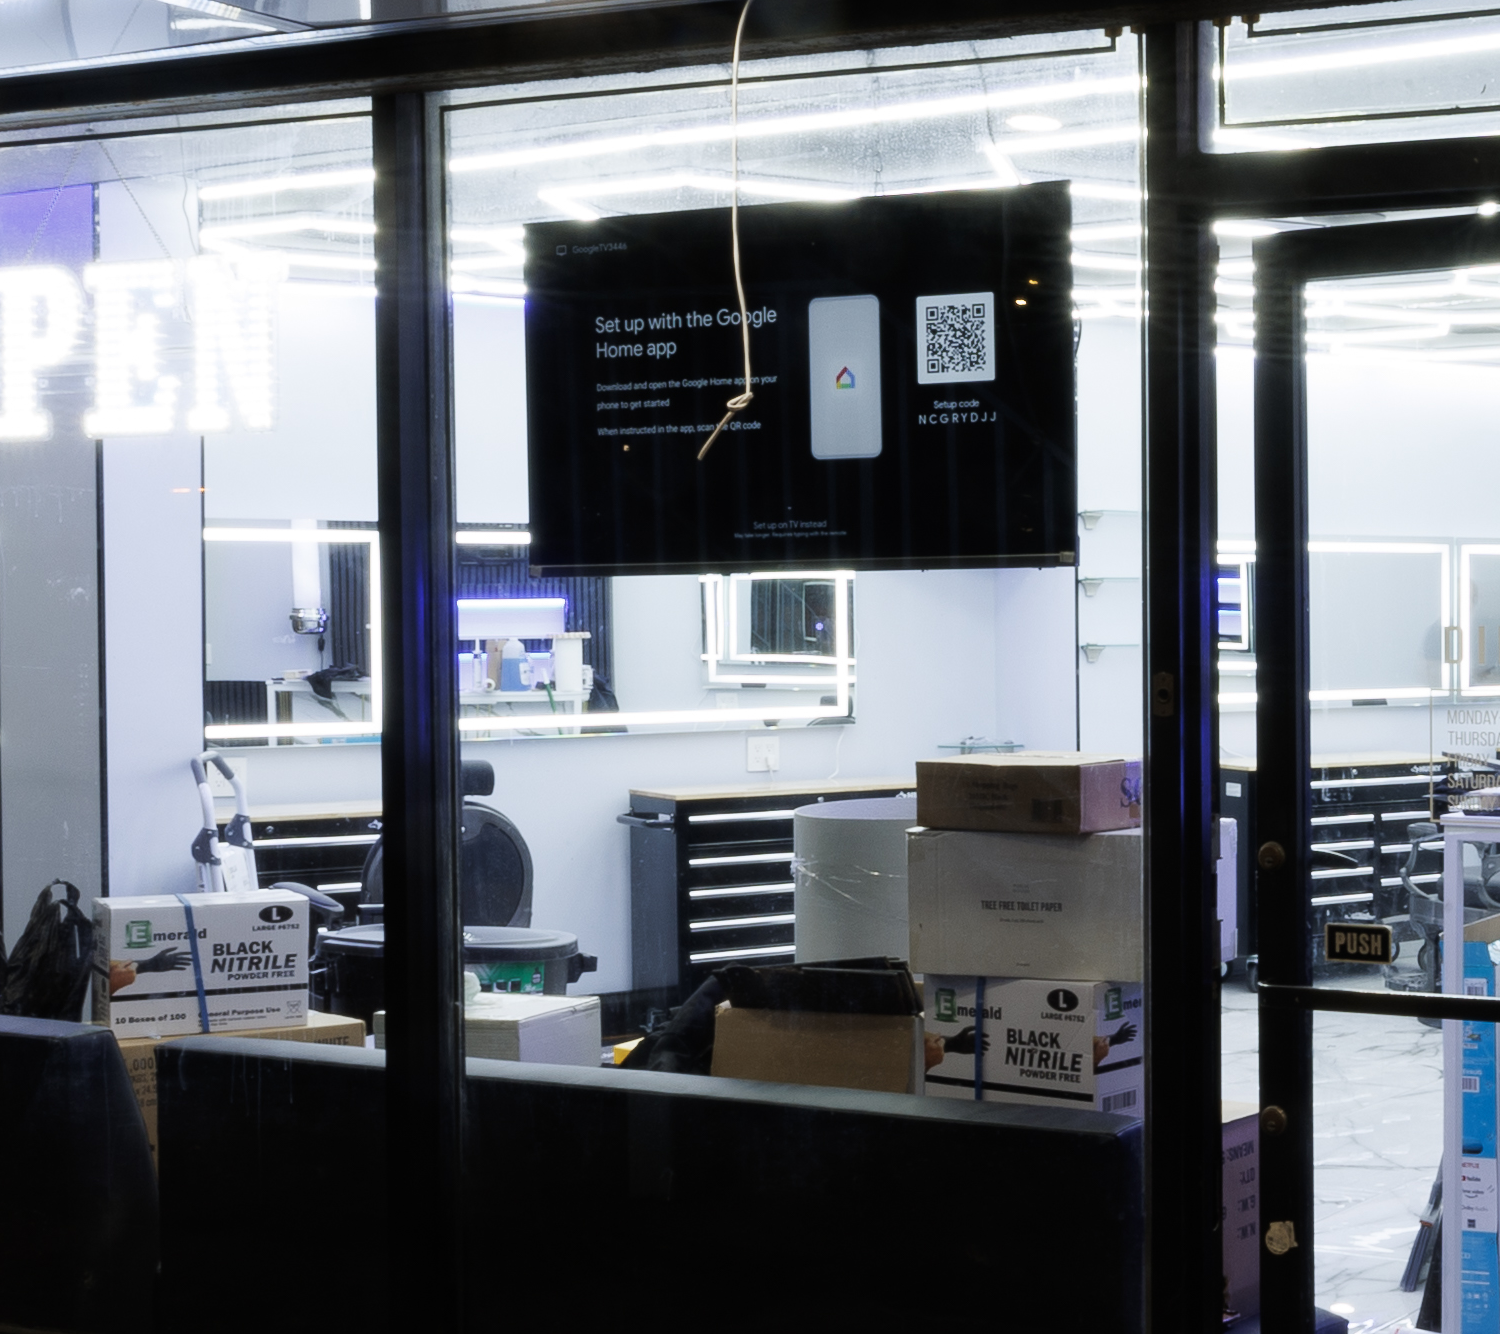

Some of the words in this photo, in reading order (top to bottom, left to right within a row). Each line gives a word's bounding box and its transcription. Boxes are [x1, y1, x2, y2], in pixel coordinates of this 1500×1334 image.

[595, 316, 620, 334] Set
[624, 318, 644, 335] up
[648, 312, 682, 330] with
[686, 310, 712, 327] the
[596, 342, 643, 358] Home
[647, 342, 677, 359] app
[596, 383, 632, 392] Download
[634, 381, 647, 390] and
[649, 381, 667, 391] open
[669, 380, 680, 388] the
[682, 378, 708, 389] Google
[710, 378, 732, 386] Home
[761, 375, 777, 385] your
[597, 401, 619, 411] phone
[621, 401, 628, 409] to
[630, 400, 642, 410] get
[643, 399, 670, 408] started
[933, 400, 957, 410] Setup
[959, 398, 980, 407] code
[918, 411, 997, 425] NCGRYDJJ
[598, 427, 618, 436] When
[620, 425, 656, 435] instructed
[657, 424, 665, 433] in
[666, 424, 678, 433] the
[697, 423, 715, 432] scan
[730, 421, 742, 431] QR
[743, 421, 761, 430] code
[1447, 753, 1491, 768] FRIDAY
[1447, 795, 1496, 812] SUNDAY
[981, 900, 997, 911] TREE
[998, 900, 1015, 911] FREE
[1017, 901, 1040, 911] TOILET
[1041, 902, 1062, 912] PAPER
[272, 908, 281, 921] L
[129, 923, 207, 944] Emerad
[252, 924, 276, 932] LARGE
[213, 941, 273, 957] BLACK
[1335, 931, 1382, 956] PUSH
[211, 953, 297, 973] NITRILE
[227, 971, 269, 981] POWDER
[271, 970, 295, 979] FREE
[938, 995, 1002, 1020] Emeald
[1059, 992, 1067, 1008] L
[115, 1017, 126, 1025] 10
[128, 1015, 156, 1024] Boxes
[158, 1014, 168, 1023] of
[170, 1013, 186, 1021] 100
[198, 1010, 229, 1018] Gneral
[1041, 1012, 1062, 1021] LARGE
[1007, 1028, 1060, 1049] BLACK
[1005, 1046, 1083, 1072] NITRILE
[1020, 1068, 1057, 1081] POWDER
[1059, 1072, 1081, 1083] FREE
